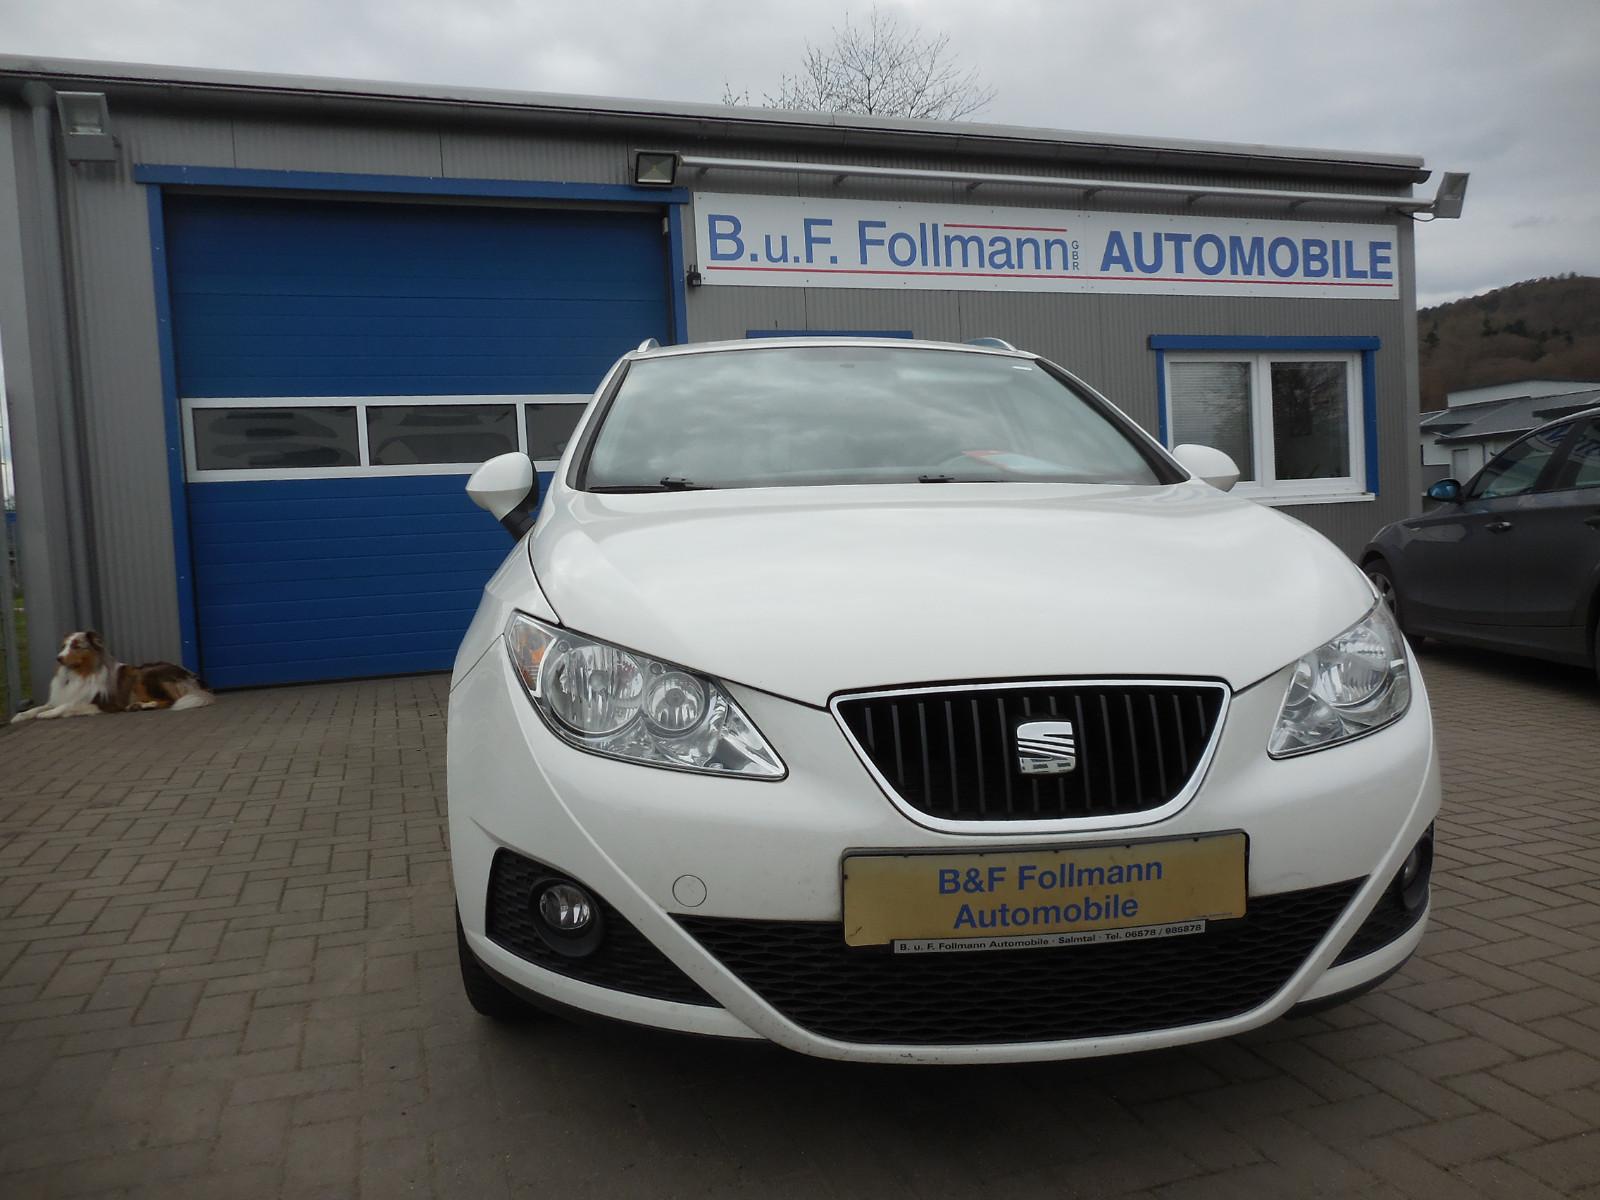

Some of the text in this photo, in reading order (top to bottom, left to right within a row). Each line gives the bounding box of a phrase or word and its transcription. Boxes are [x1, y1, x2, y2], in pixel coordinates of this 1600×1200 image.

[707, 214, 1069, 270] B.u.F. Follmann
[1099, 230, 1393, 279] AUTOMOBILE
[938, 861, 1163, 894] B&F Follmann
[953, 894, 1139, 929] Automobile
[938, 941, 986, 950] Follmann
[989, 938, 1049, 948] Automobile
[1058, 934, 1096, 944] Salmtal
[1105, 933, 1122, 941] Tel.
